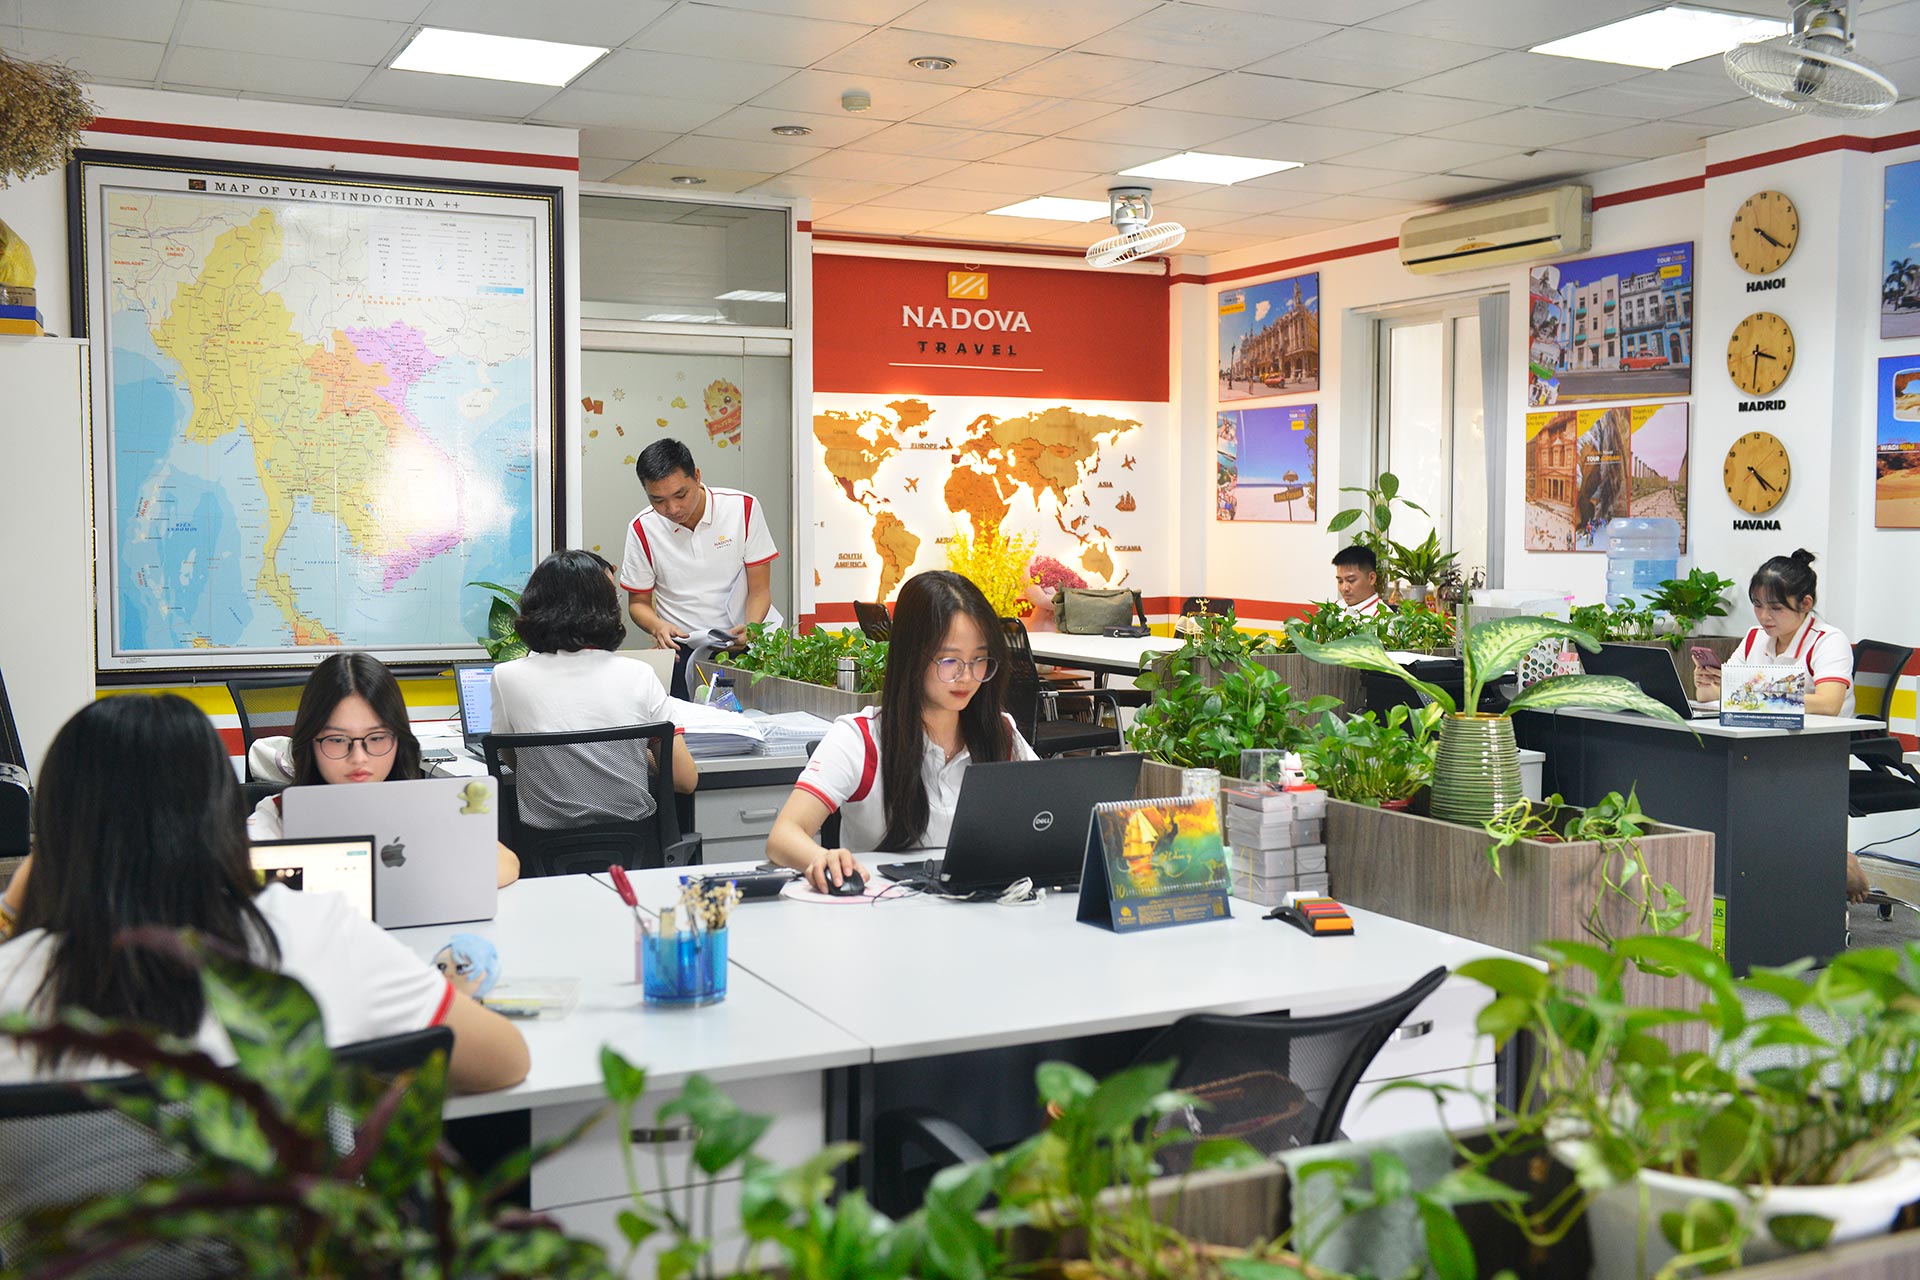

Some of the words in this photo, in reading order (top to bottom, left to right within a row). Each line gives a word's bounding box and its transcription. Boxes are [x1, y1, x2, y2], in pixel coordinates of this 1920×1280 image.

[215, 182, 250, 193] MAP
[259, 185, 280, 196] OF
[289, 187, 435, 208] VIAJEINDOCHINA
[1746, 278, 1786, 292] HANOI
[902, 305, 1032, 332] NADOVA
[918, 341, 1017, 356] TRAVEL
[1738, 400, 1786, 412] MADRID
[1733, 520, 1781, 530] HAVANA
